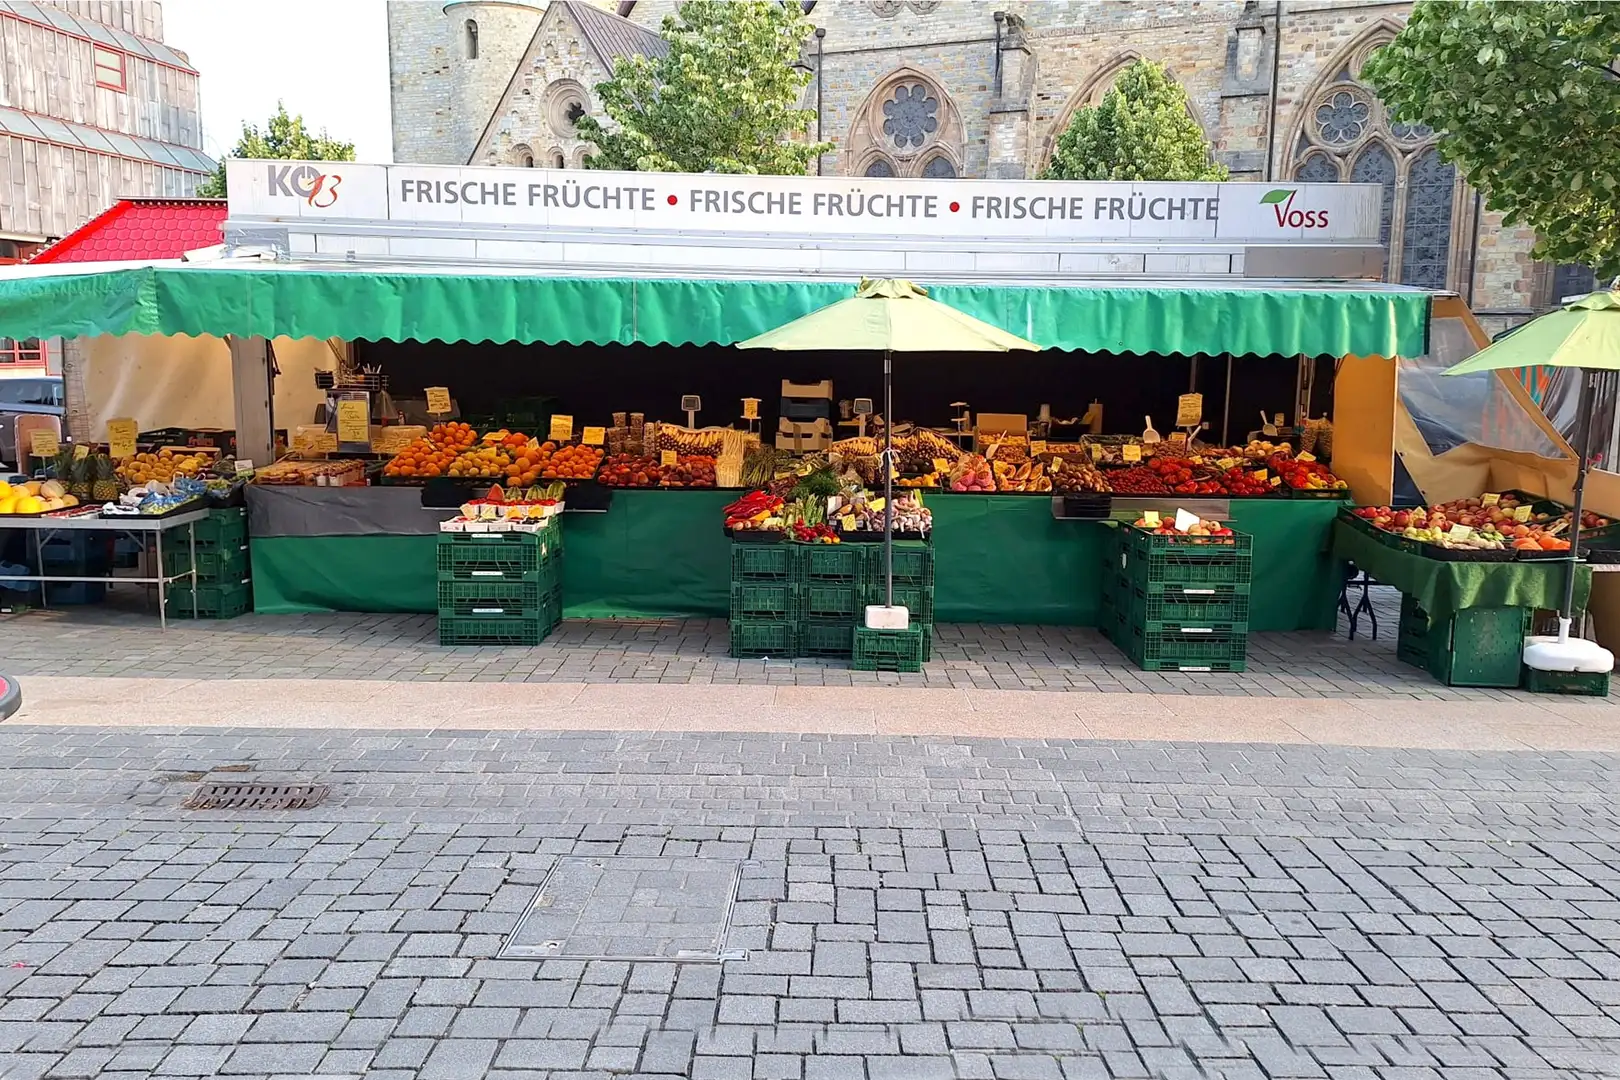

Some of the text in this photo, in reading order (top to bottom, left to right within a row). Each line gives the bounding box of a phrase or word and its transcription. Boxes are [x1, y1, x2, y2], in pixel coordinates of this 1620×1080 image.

[401, 180, 1220, 220] FRISCHE FRÜCHTE FRISCHE FRÜCHTE FRISCHE FRÜCHTE
